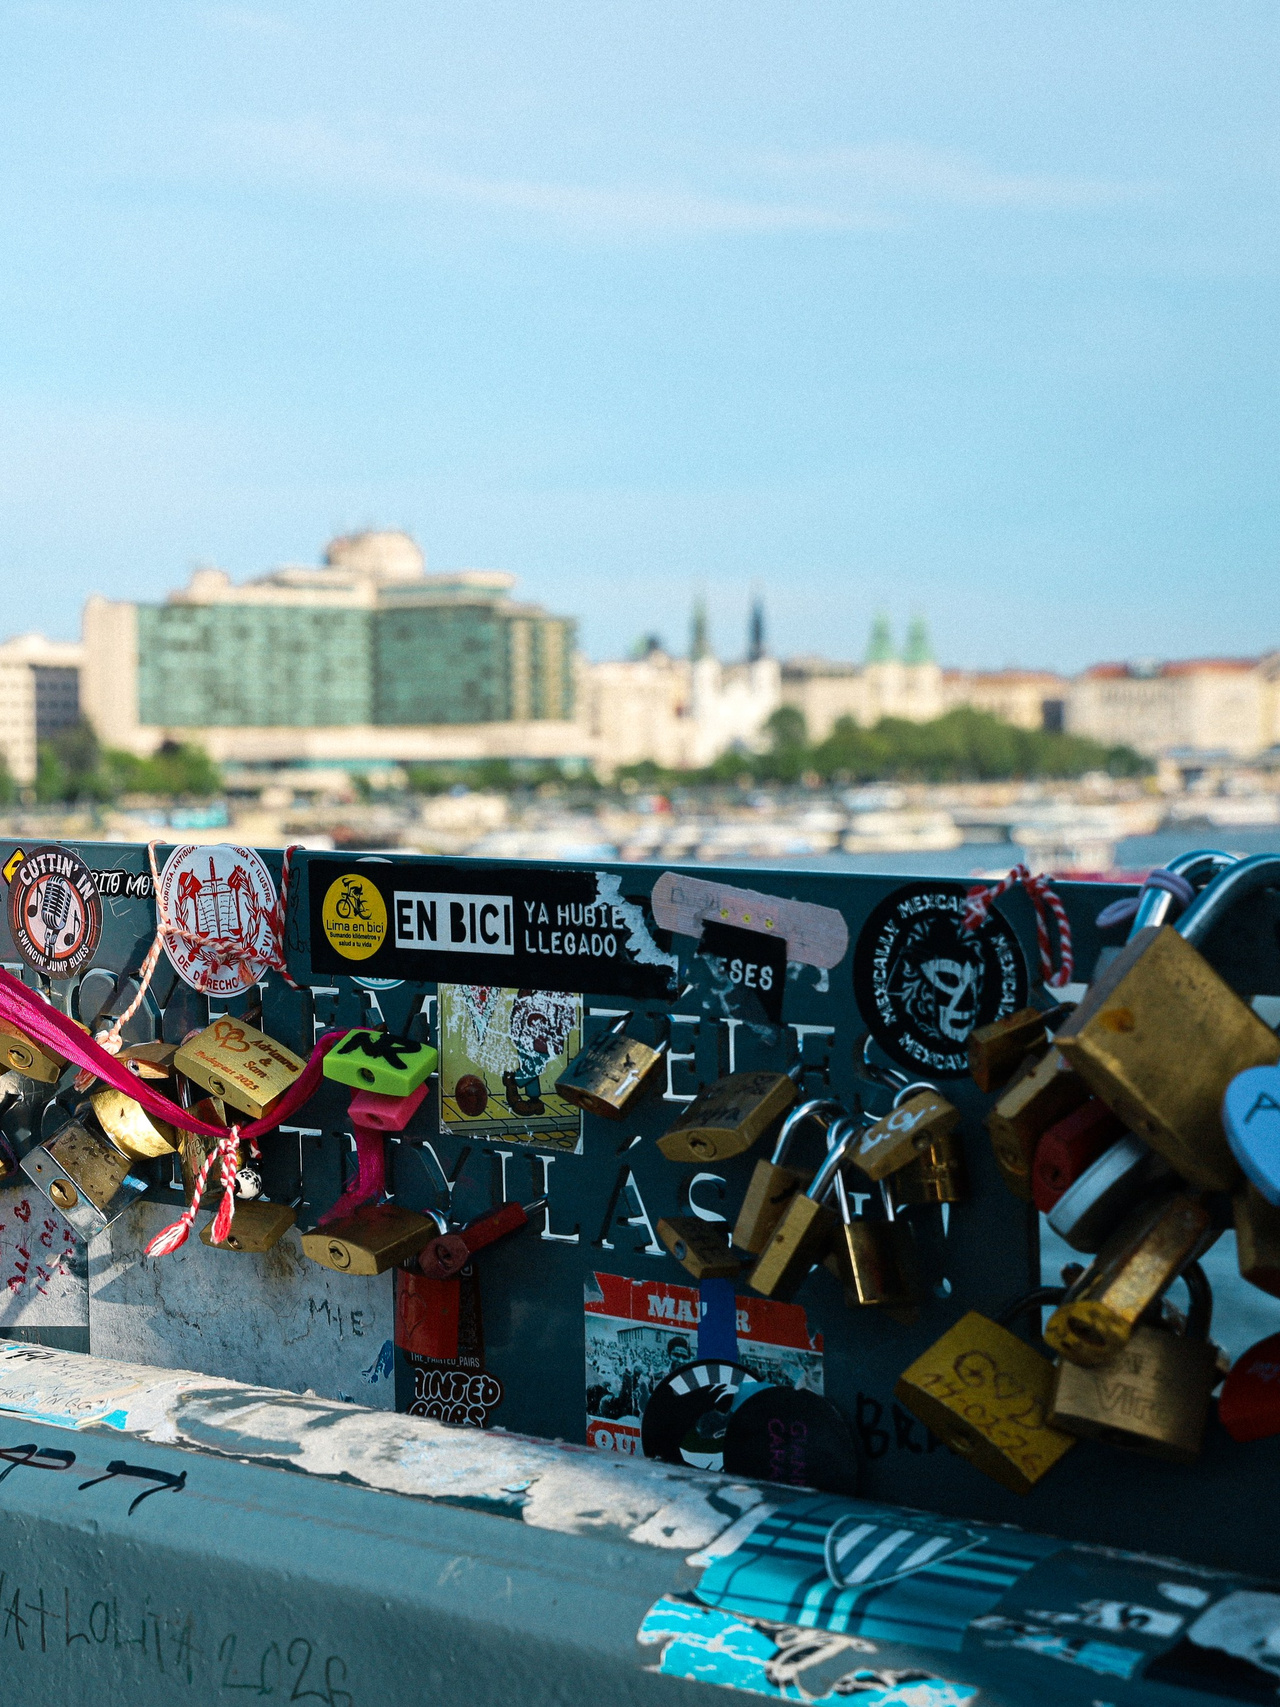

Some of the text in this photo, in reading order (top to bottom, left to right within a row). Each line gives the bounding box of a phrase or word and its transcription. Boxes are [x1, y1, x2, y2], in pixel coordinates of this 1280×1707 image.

[20, 853, 95, 901] CUTTIN' IN
[396, 899, 512, 946] EN BICI
[524, 900, 550, 925] YA
[326, 919, 384, 933] Lima en bici
[329, 931, 352, 939] Sumando
[18, 929, 90, 973] SWINGIN' JUMP BLUES
[338, 940, 352, 948] salud
[361, 940, 372, 948] vida
[524, 930, 618, 957] LLEGADO
[178, 955, 191, 972] DE
[193, 970, 239, 991] DRECHO
[234, 1073, 260, 1091] 2025
[243, 1061, 268, 1079] Sam
